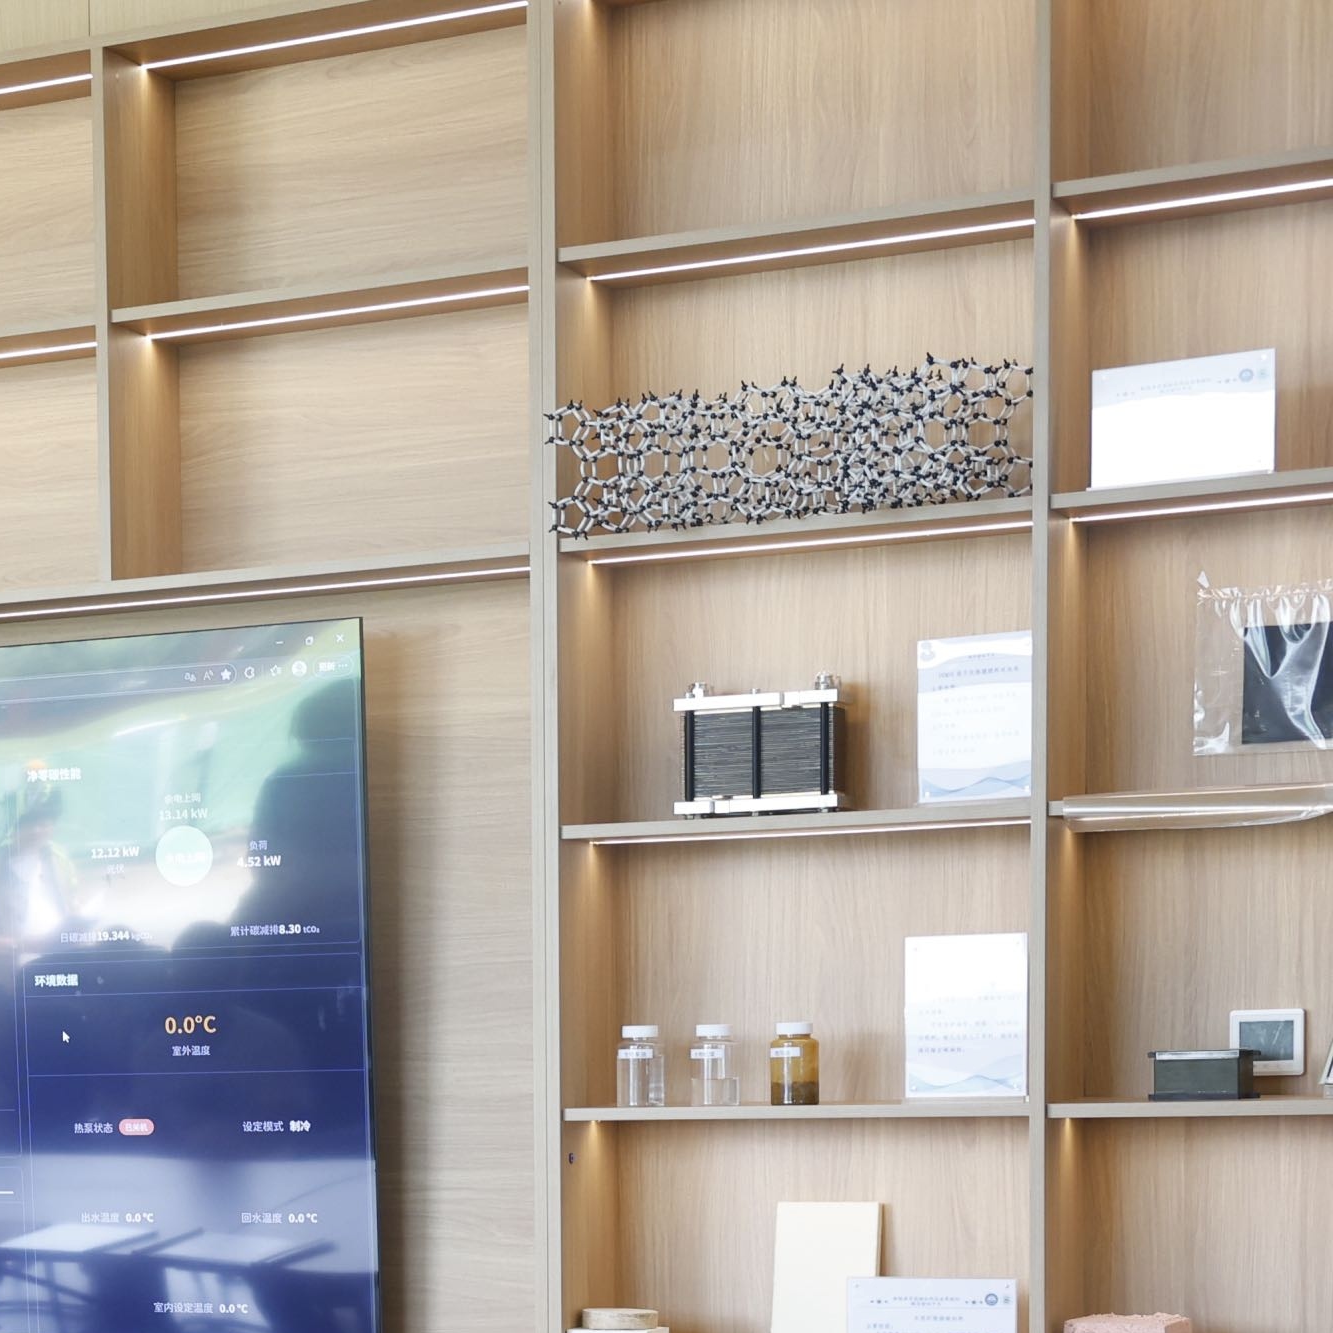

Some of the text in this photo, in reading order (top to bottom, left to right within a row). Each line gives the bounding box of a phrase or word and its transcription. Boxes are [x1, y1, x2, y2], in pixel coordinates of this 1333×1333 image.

[191, 808, 208, 820] kW
[249, 840, 268, 851] 负荷
[91, 846, 139, 859] 12.12 kW
[237, 855, 281, 868] 4.52 kW
[279, 923, 301, 935] 8.30
[34, 974, 79, 988] 环境数据
[172, 1045, 211, 1057] 室外温度
[74, 1122, 113, 1134] 热泵状态
[242, 1121, 311, 1132] 设定模式 制冷
[81, 1213, 120, 1223] 出水温度
[241, 1213, 282, 1224] 回水温度
[153, 1302, 214, 1314] 室内设定温度
